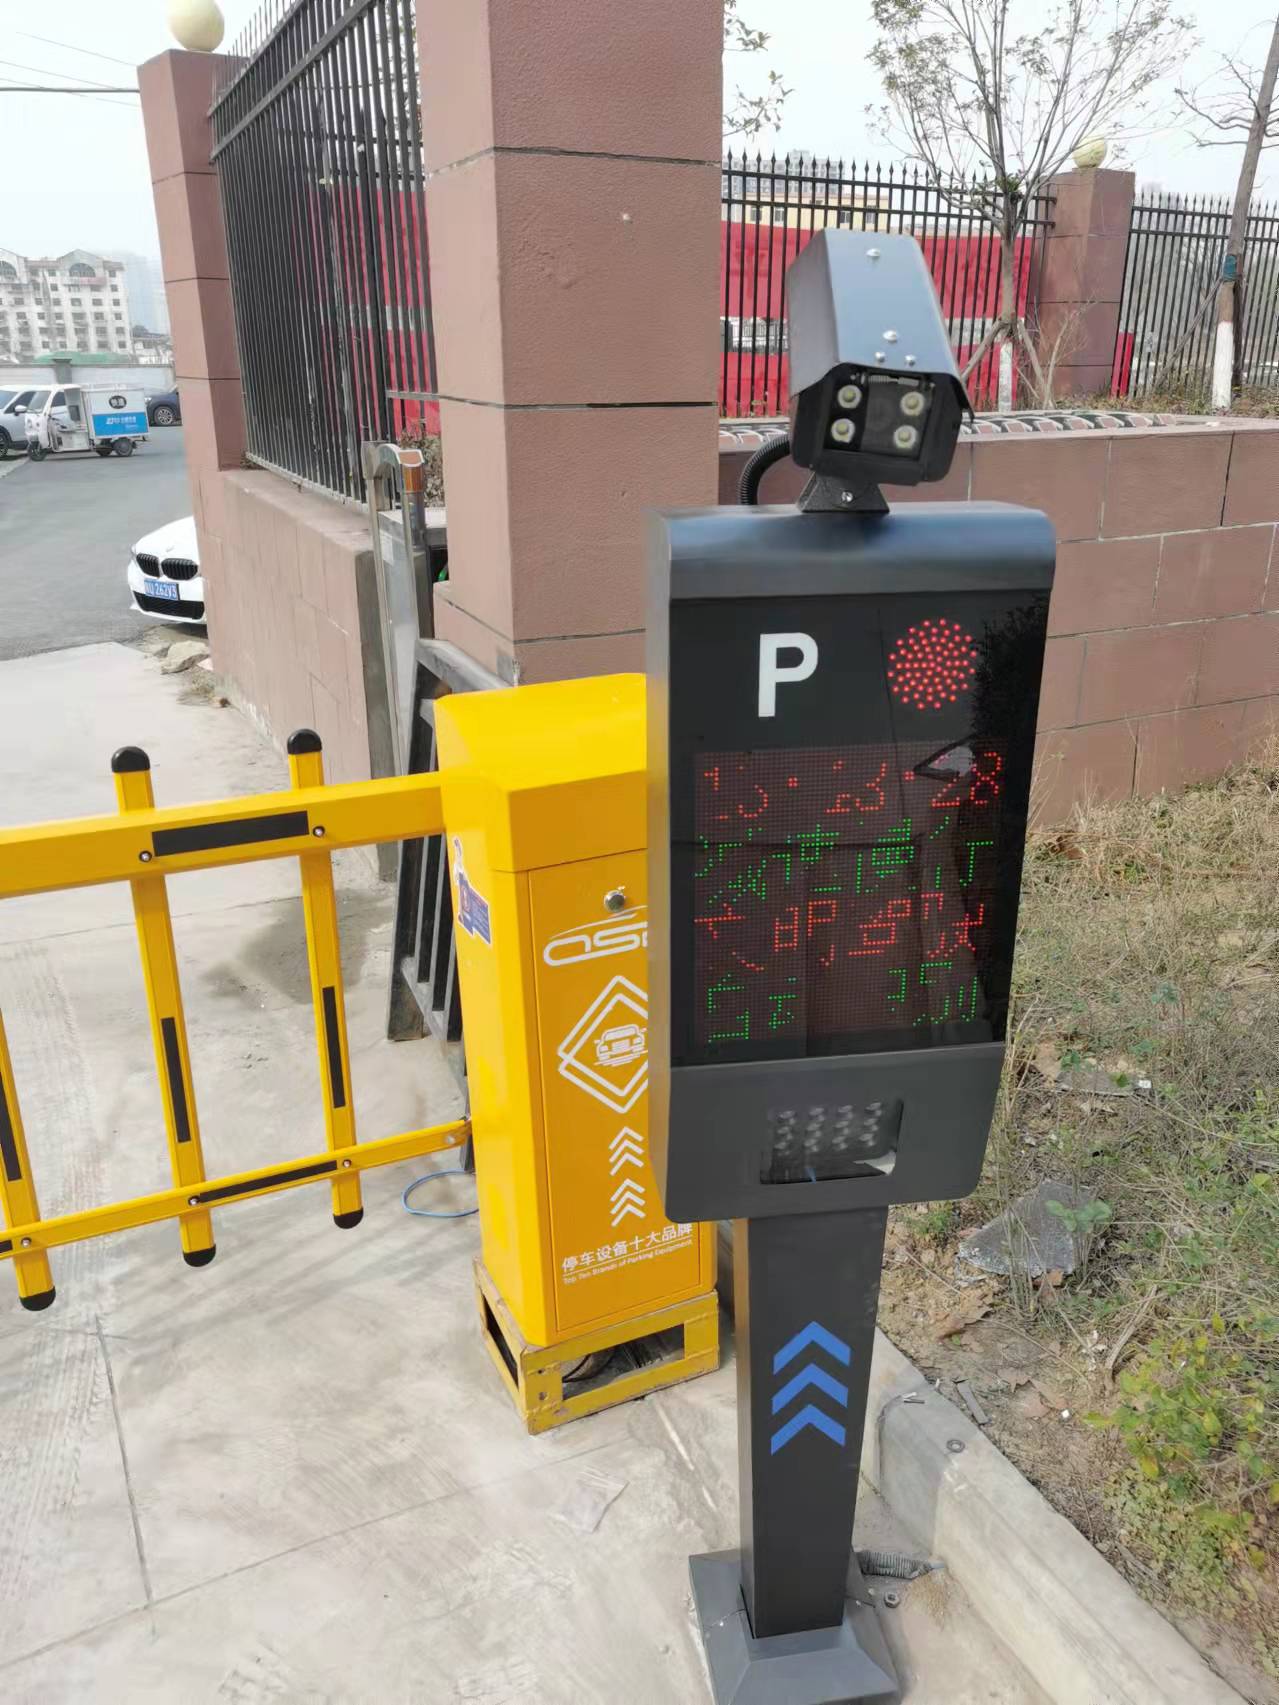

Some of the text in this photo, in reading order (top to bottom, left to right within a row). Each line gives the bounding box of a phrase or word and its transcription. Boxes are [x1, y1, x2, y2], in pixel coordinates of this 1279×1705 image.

[758, 632, 818, 717] P
[561, 1223, 693, 1273] 停车设备十大品牌
